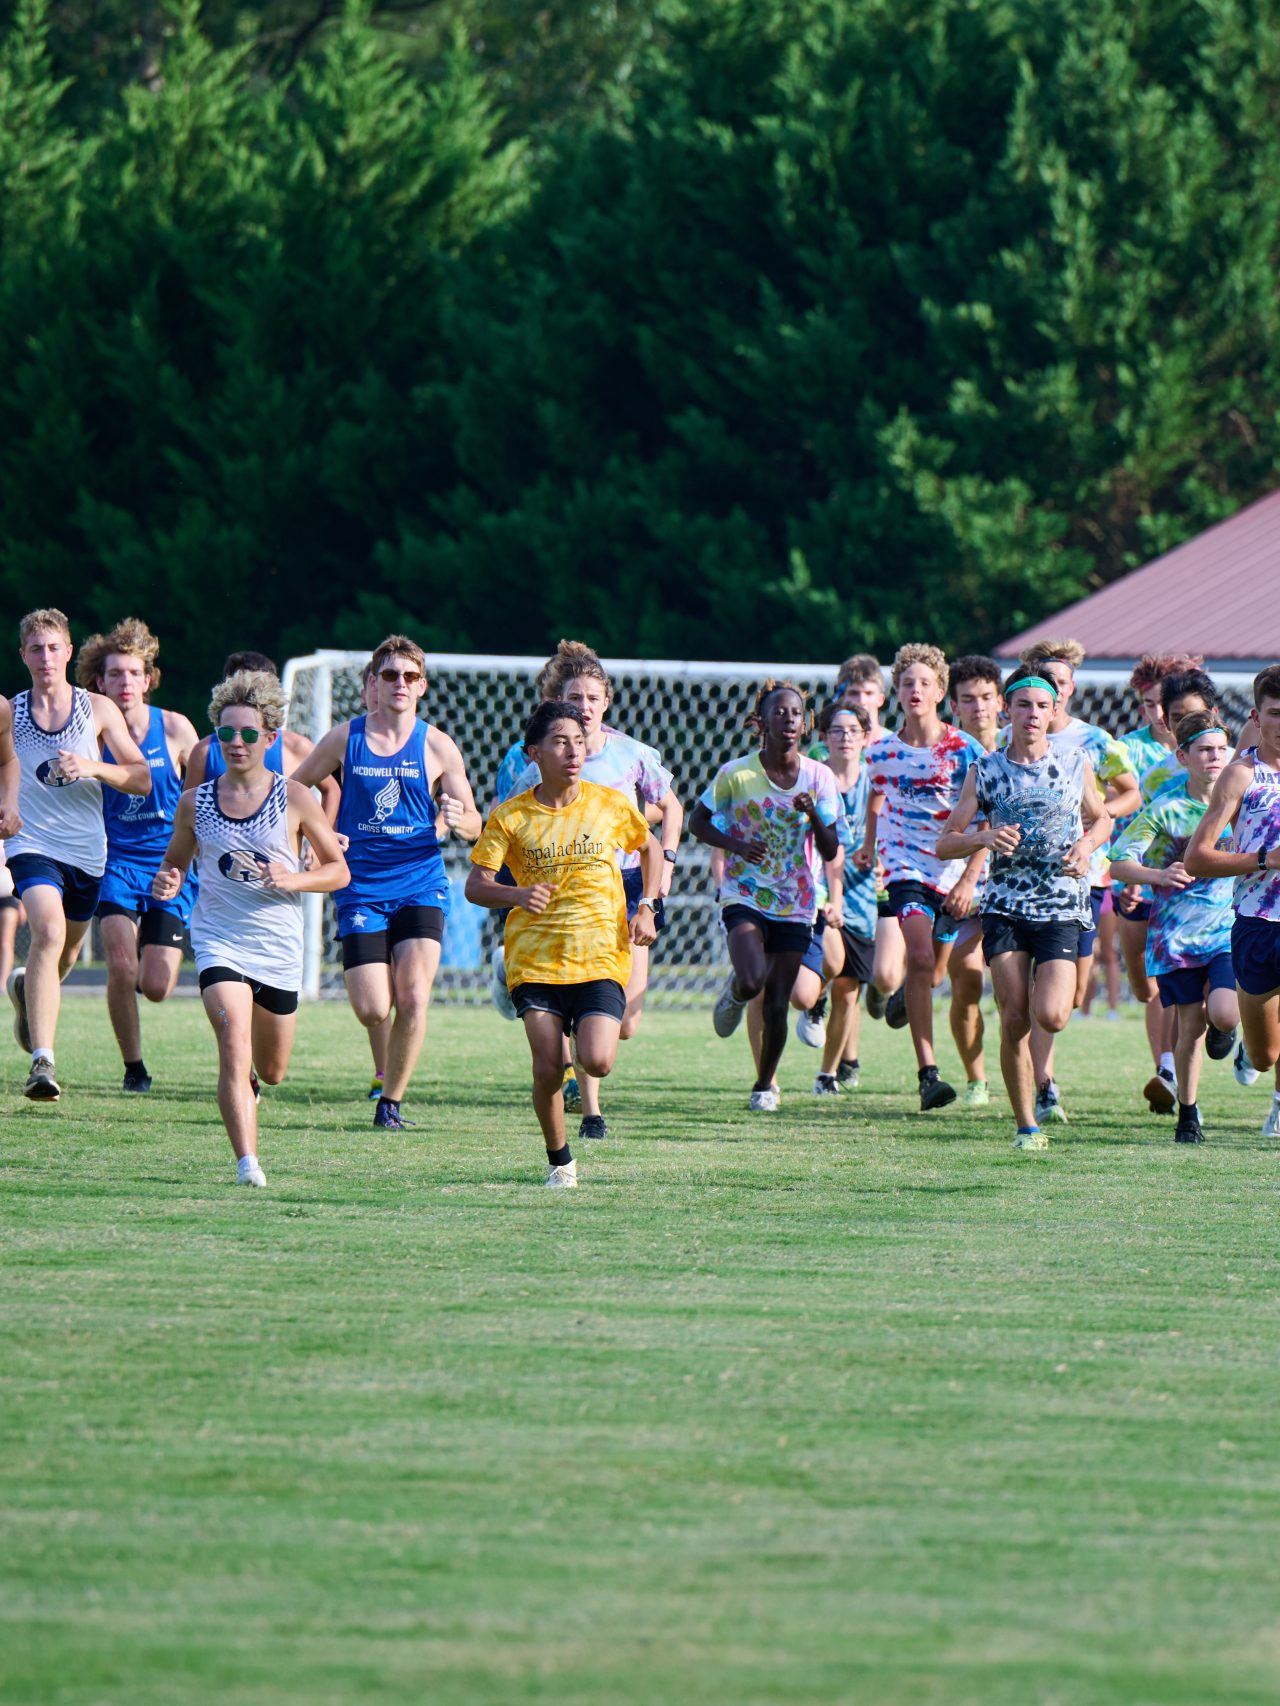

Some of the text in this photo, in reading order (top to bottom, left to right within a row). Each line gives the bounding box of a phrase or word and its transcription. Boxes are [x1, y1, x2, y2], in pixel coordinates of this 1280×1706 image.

[352, 766, 420, 778] MCDOWELL TITANS
[358, 822, 415, 835] CROSS COUNTRY
